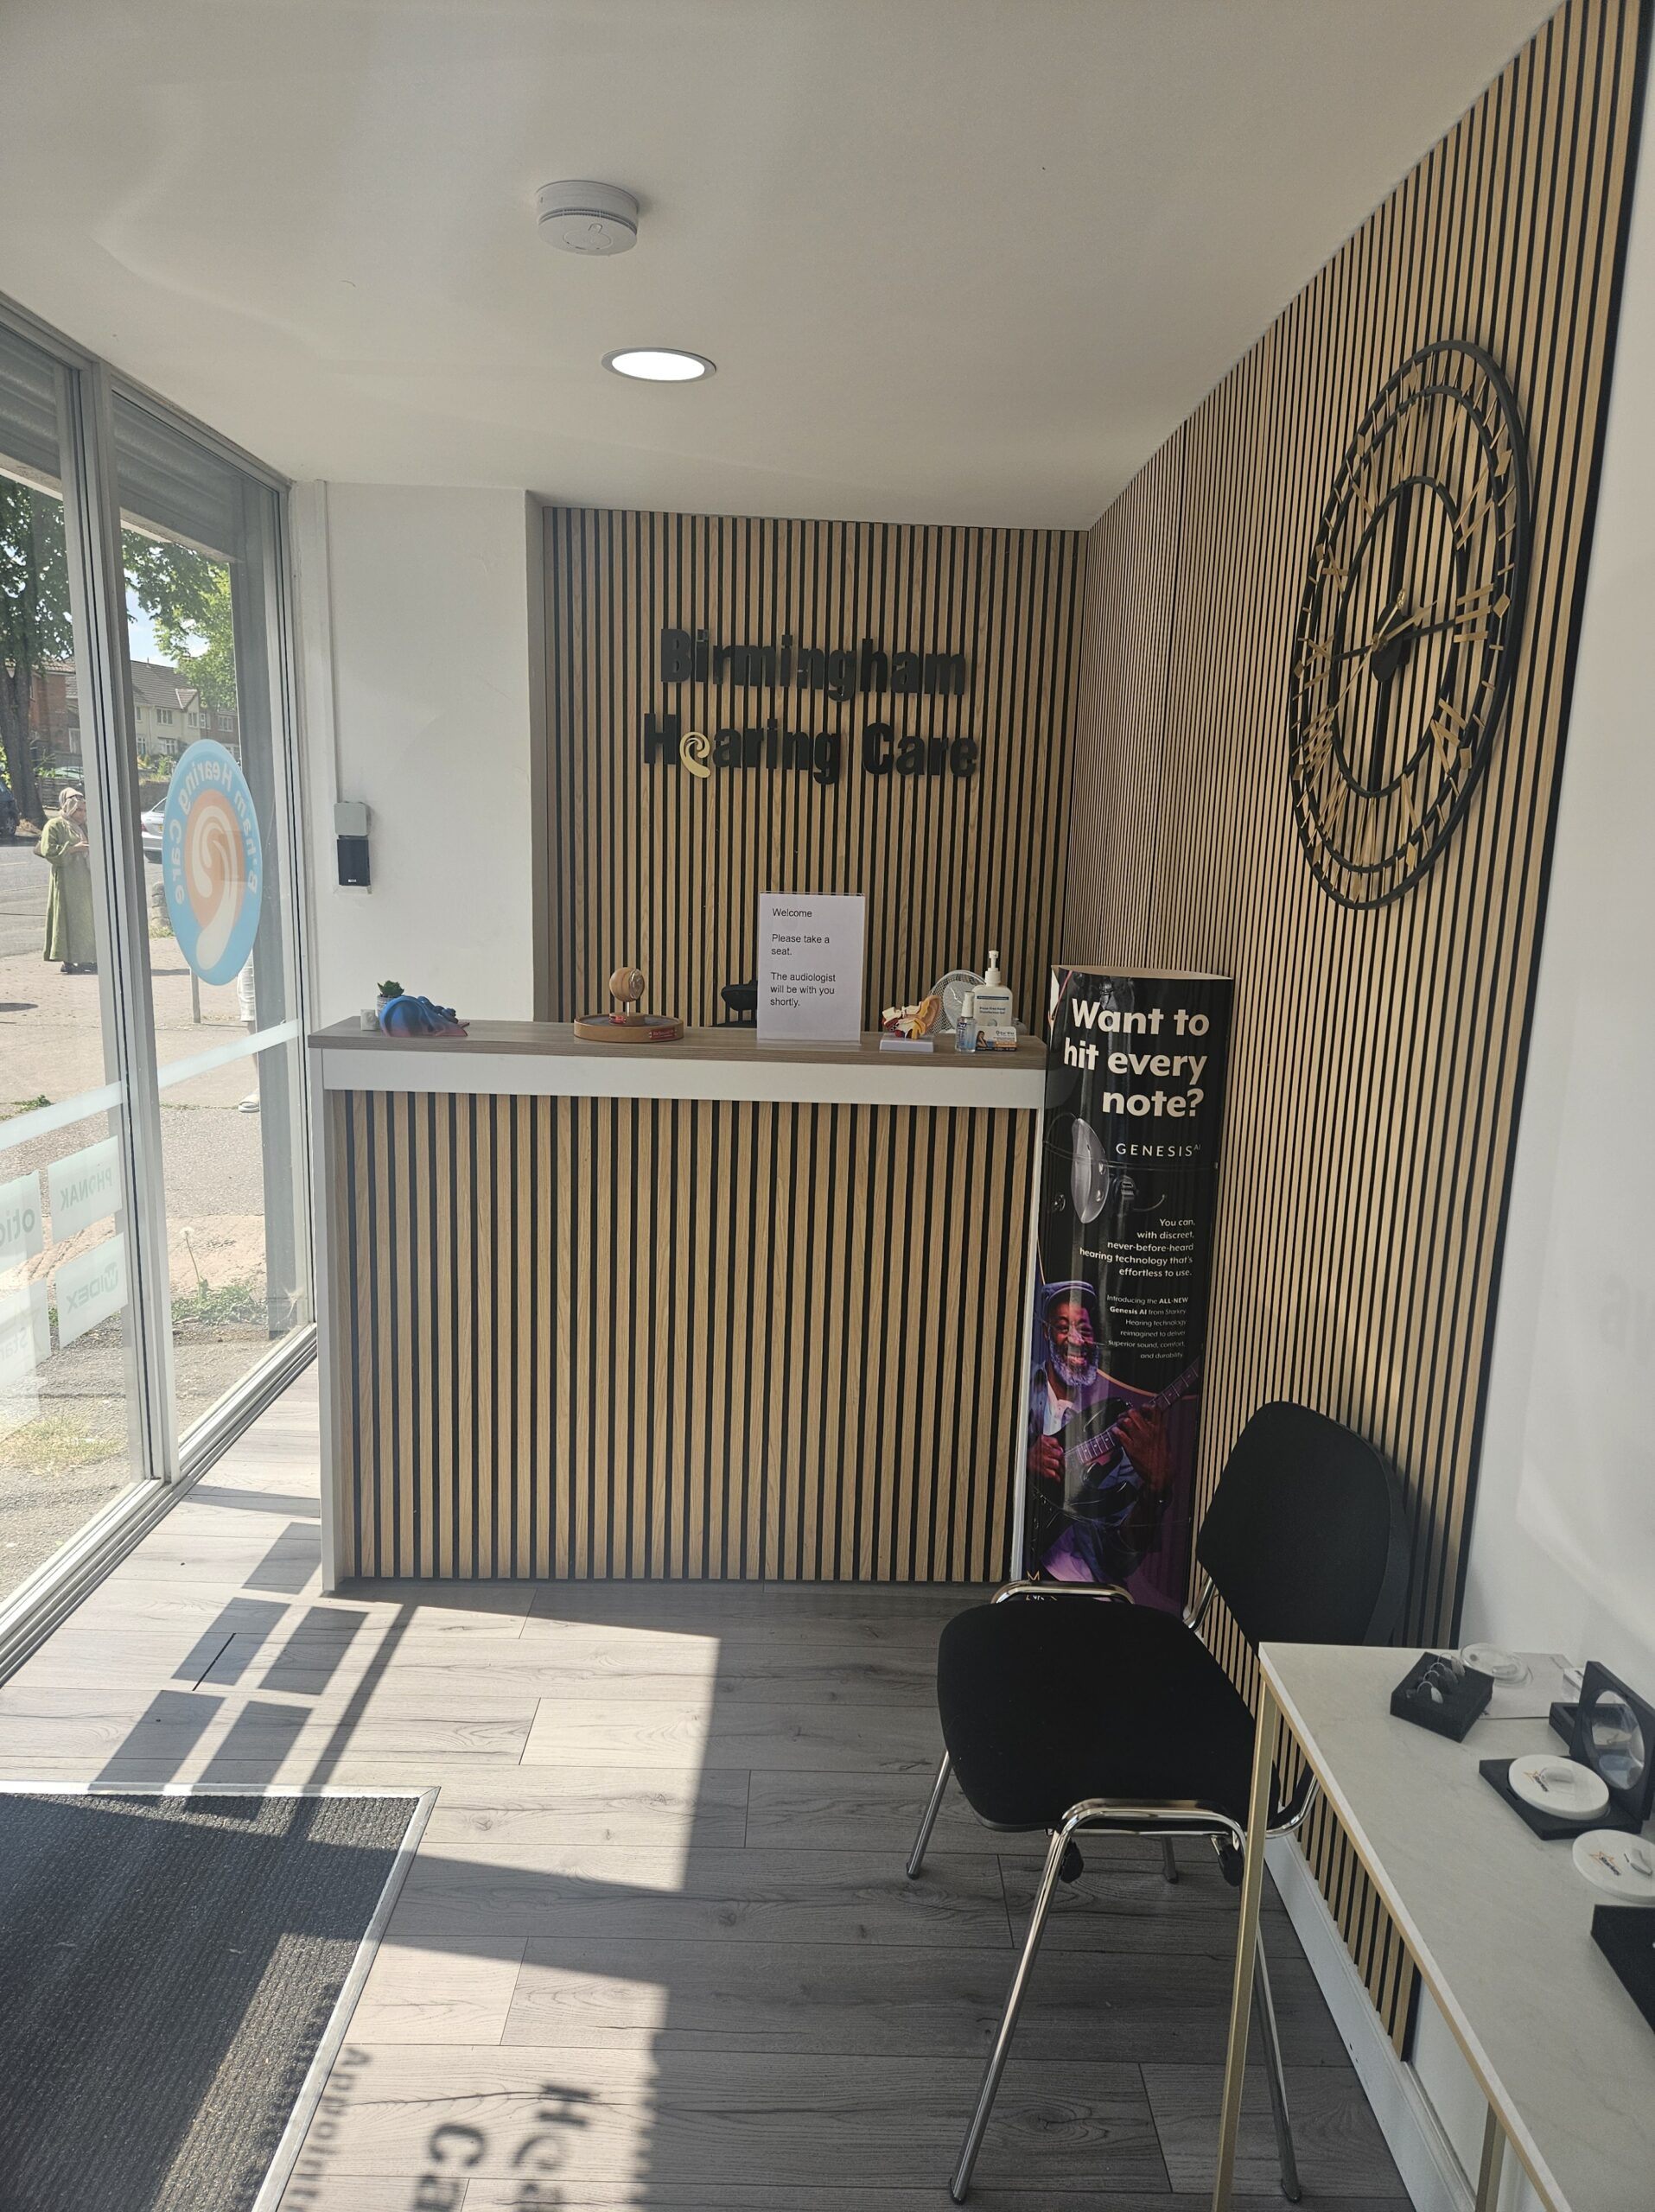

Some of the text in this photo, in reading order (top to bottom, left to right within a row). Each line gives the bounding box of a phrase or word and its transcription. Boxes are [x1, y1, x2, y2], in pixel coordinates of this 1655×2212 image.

[660, 628, 966, 702] Birmingham
[863, 721, 977, 778] Care
[772, 908, 812, 918] Welcome
[772, 934, 801, 943] Please
[804, 935, 822, 944] take
[771, 972, 836, 984] The audiologist
[770, 985, 835, 996] will be with you
[770, 997, 800, 1008] shortly.
[1072, 998, 1210, 1036] Want to
[1063, 1037, 1208, 1085] hit every
[1102, 1088, 1205, 1118] note?
[1116, 1142, 1193, 1157] GENESIS
[1159, 1218, 1176, 1227] You
[1136, 1230, 1157, 1239] with
[1107, 1242, 1194, 1252] never-before-heard
[1079, 1247, 1194, 1267] hearing technology that's
[1119, 1268, 1162, 1278] effortless
[1106, 1294, 1146, 1306] Introducing
[1110, 1306, 1138, 1315] Genesis
[1125, 1319, 1153, 1328] Hearing
